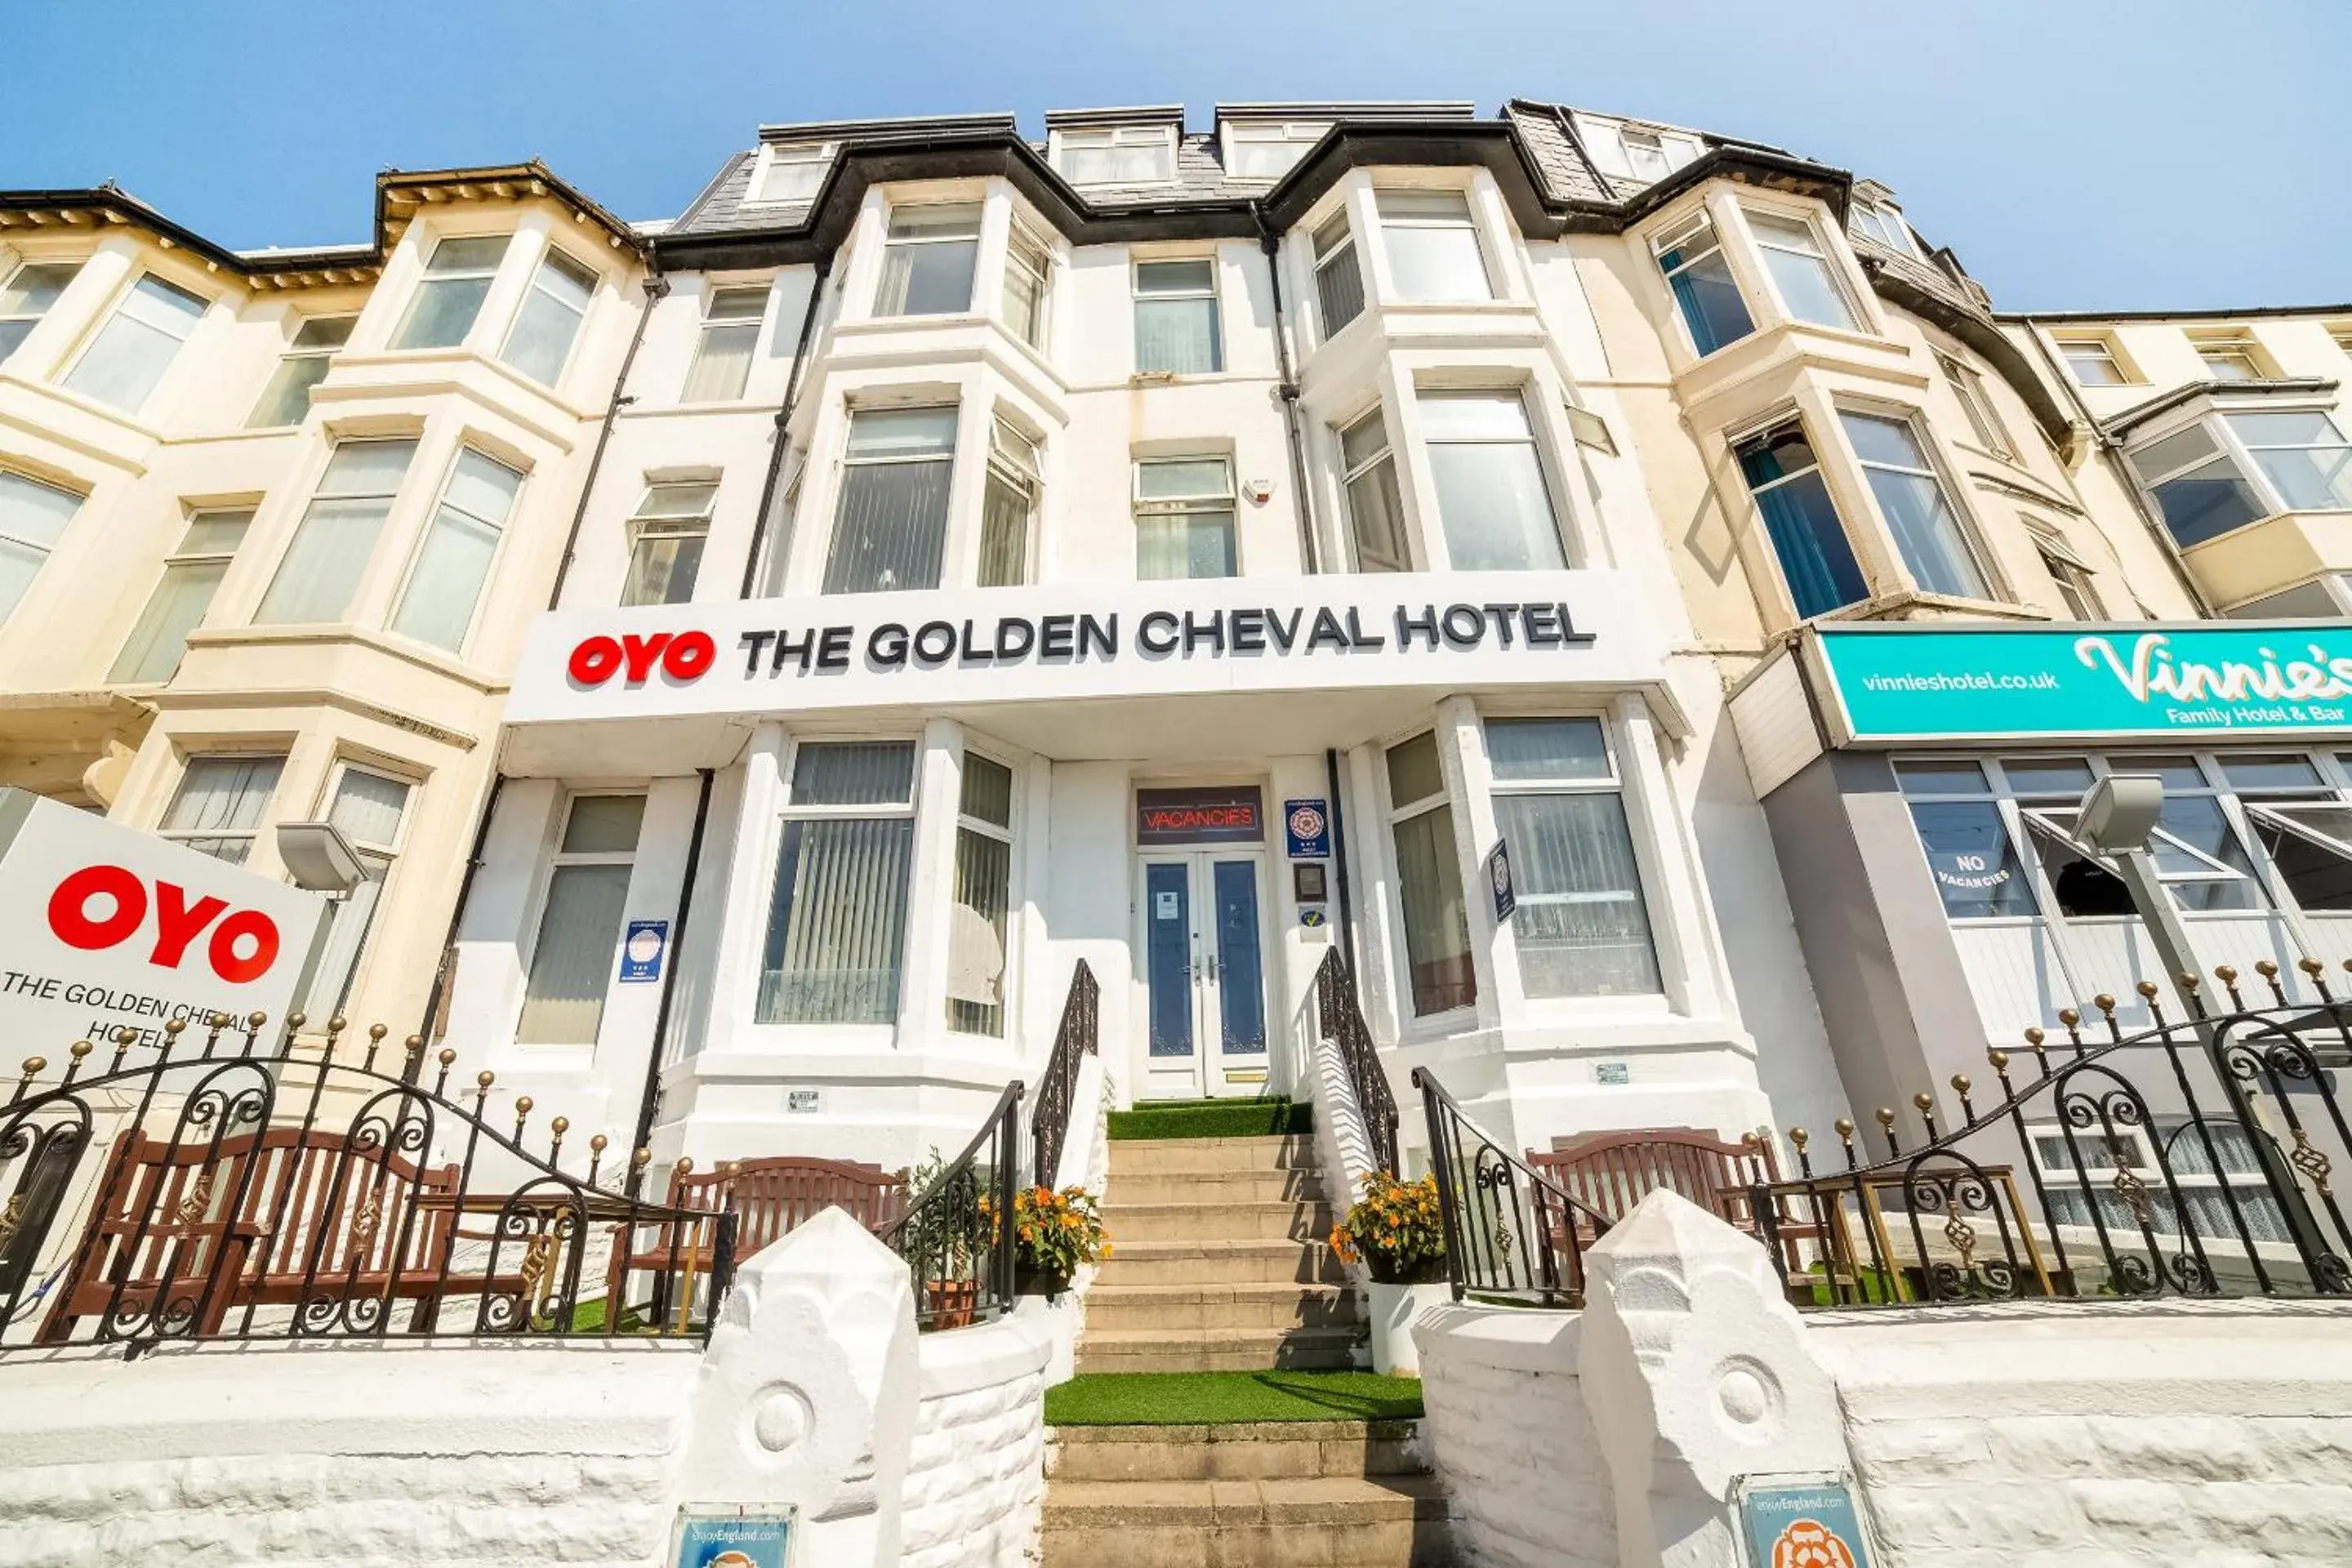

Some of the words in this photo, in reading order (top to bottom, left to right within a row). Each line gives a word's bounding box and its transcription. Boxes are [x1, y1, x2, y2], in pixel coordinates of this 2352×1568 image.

[741, 626, 853, 672] THE
[868, 613, 1118, 664] GOLDEN
[1139, 607, 1385, 653] CHEVAL
[1396, 603, 1597, 645] HOTEL
[567, 630, 715, 685] OYO
[1862, 671, 2060, 692] vinnieshotel.co.uk
[2167, 707, 2231, 726] Family
[2234, 706, 2287, 723] Hotel
[2289, 706, 2306, 720] &
[2309, 705, 2345, 720] Bar
[1143, 808, 1253, 827] VACANCIES
[1956, 855, 1986, 871] NO
[1938, 869, 2010, 889] VACANCIES
[47, 865, 279, 983] OYO
[2, 971, 61, 999] THE
[65, 983, 169, 1018] GOLDEN
[172, 1003, 248, 1033] CHEAL
